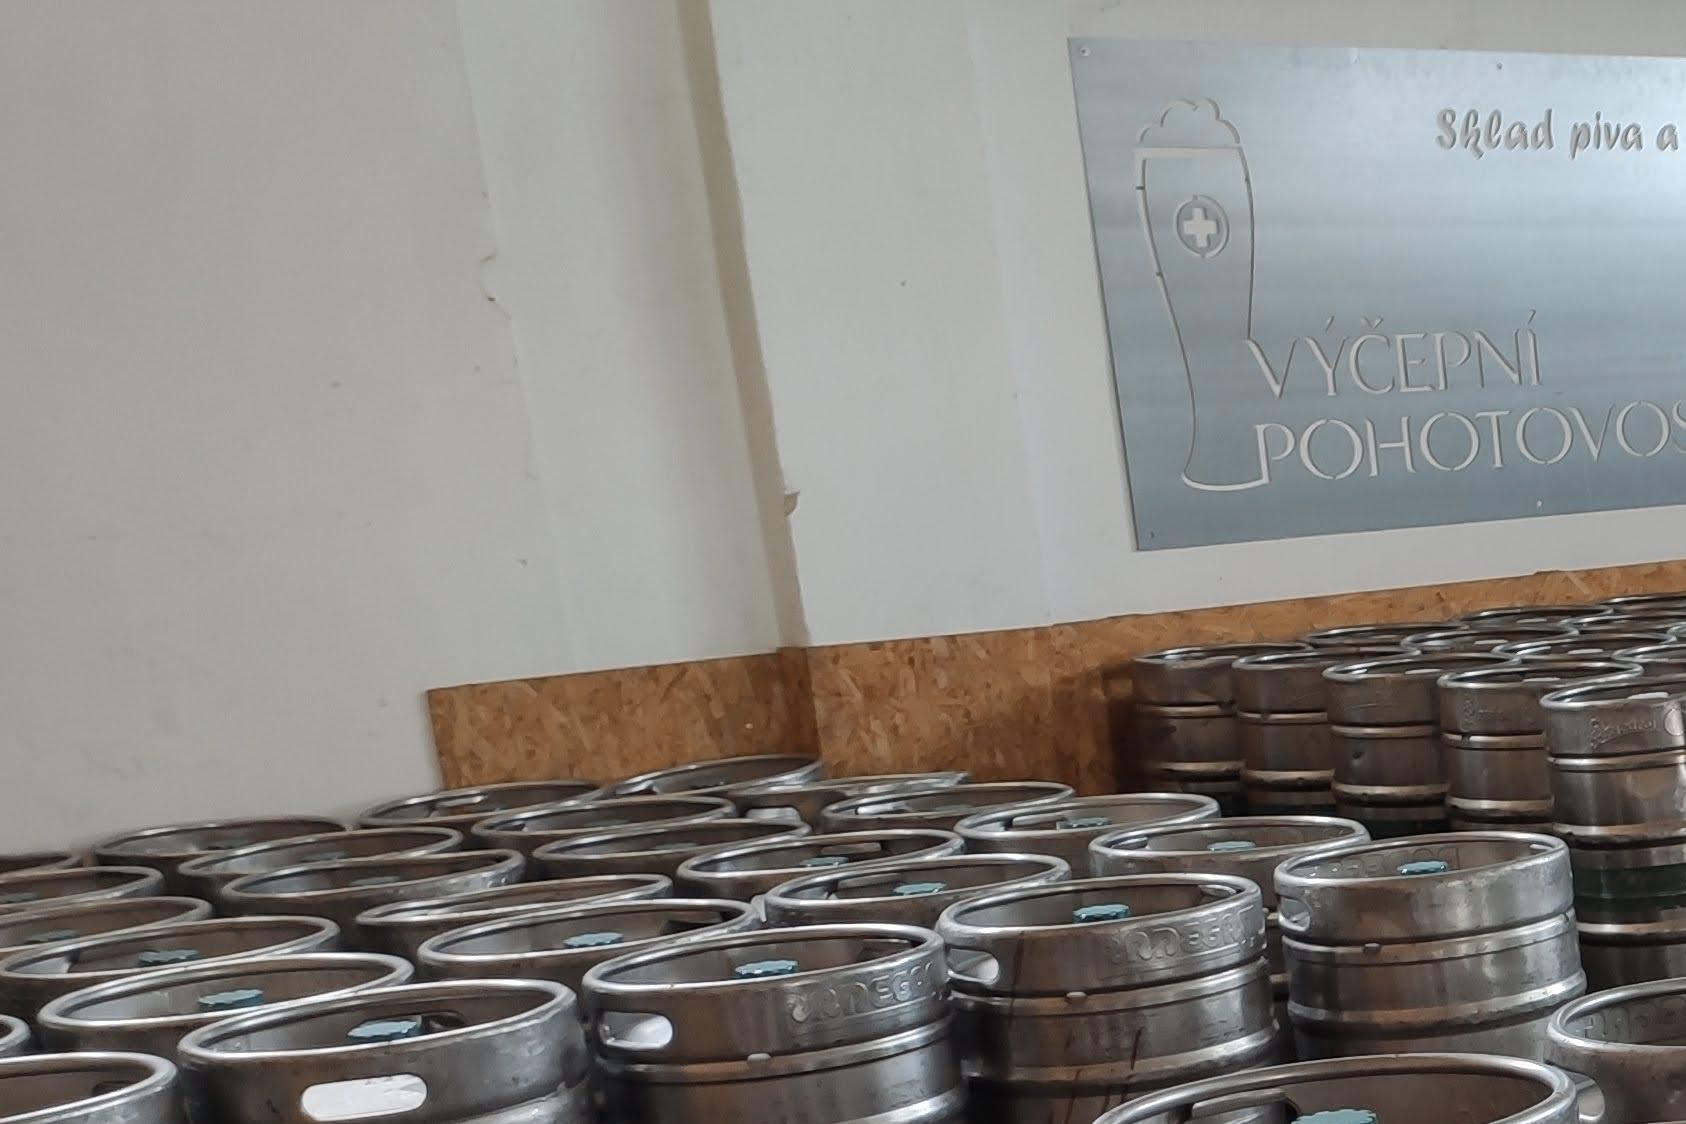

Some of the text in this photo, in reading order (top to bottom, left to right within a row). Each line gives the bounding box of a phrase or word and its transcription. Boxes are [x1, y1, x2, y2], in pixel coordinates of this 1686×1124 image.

[1437, 108, 1554, 160] Sklad
[1570, 110, 1644, 160] piva
[1657, 126, 1679, 153] a
[1249, 310, 1544, 398] VÝČEPNÍ
